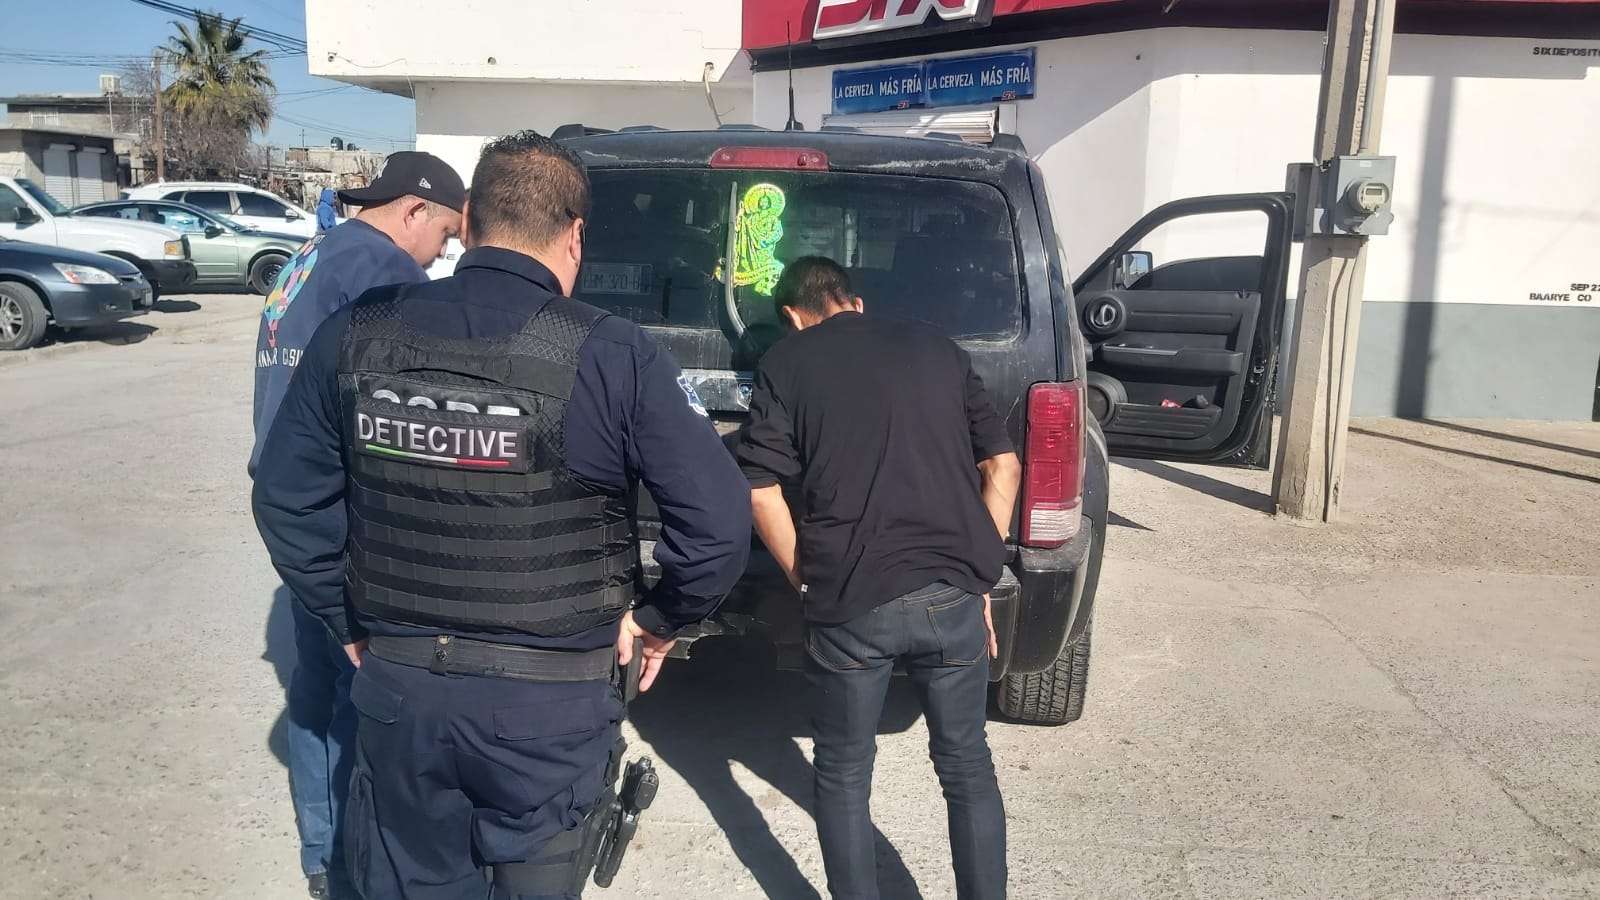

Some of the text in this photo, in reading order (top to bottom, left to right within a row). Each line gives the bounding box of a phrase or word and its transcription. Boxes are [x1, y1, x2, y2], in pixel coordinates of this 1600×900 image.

[1552, 47, 1600, 57] DEPOSIT
[834, 74, 923, 99] LA CERVEZA MÁS FRÍA
[927, 62, 1031, 91] LA CERVEZA MÁS FRÍA
[1570, 283, 1590, 291] SEP
[358, 413, 517, 458] DETECTIVE
